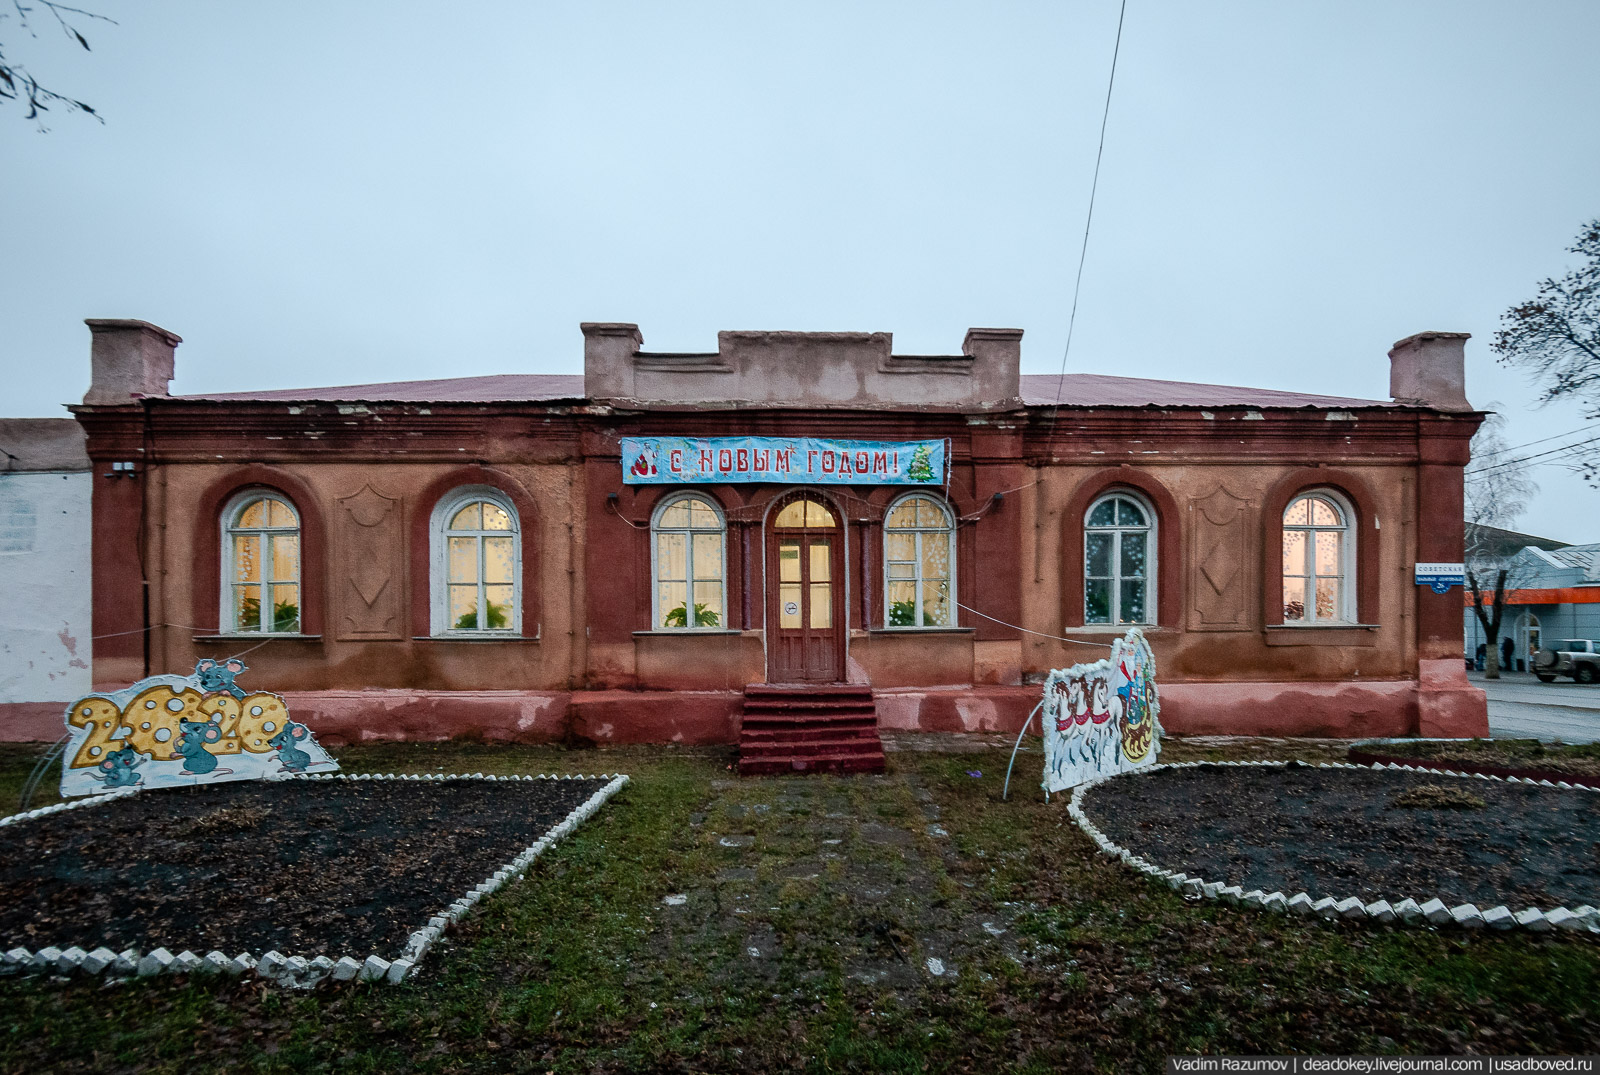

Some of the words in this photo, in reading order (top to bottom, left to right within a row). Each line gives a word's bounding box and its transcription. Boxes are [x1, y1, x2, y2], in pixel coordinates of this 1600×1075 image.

[670, 449, 683, 473] С
[700, 447, 791, 474] НОВЫМ
[806, 449, 898, 479] ГОДОМ!
[69, 685, 290, 769] 2020
